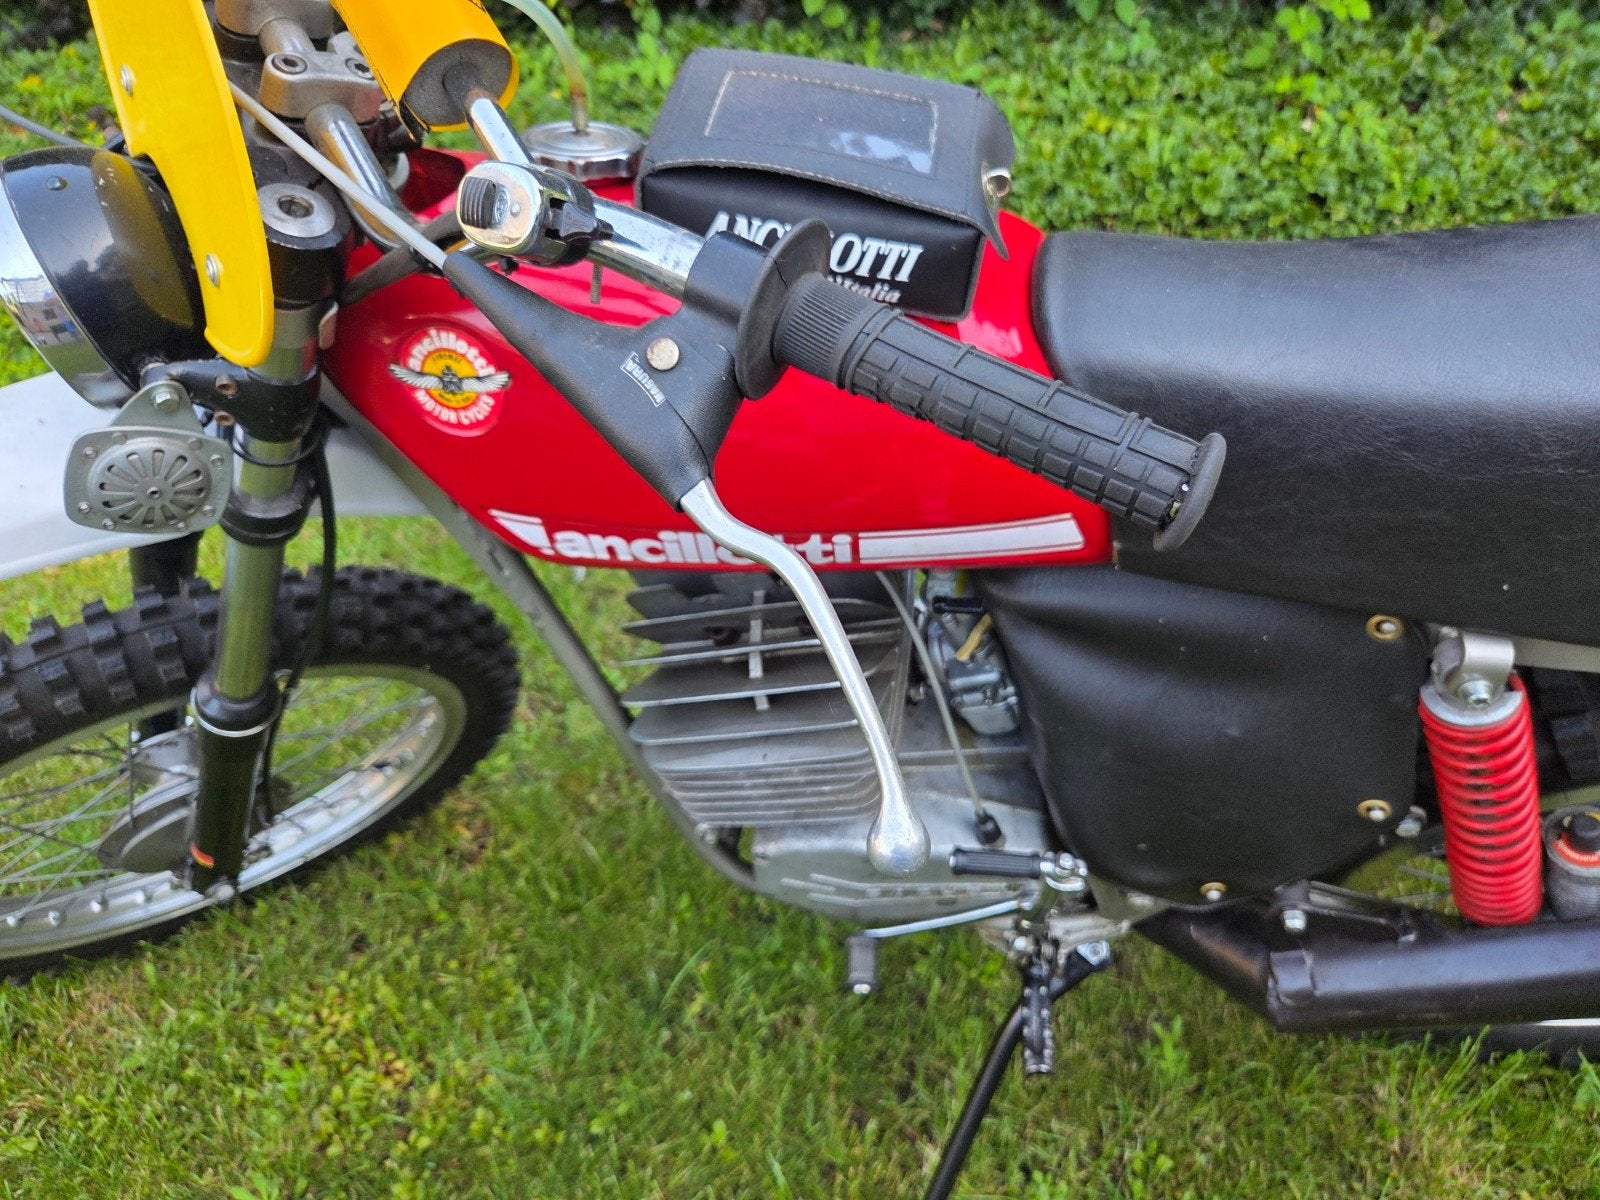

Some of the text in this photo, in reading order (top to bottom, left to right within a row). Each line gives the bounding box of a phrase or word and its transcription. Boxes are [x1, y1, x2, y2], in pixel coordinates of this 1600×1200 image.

[624, 359, 666, 404] MAGURA
[414, 388, 459, 425] MOTOR
[551, 530, 852, 564] ancillti
